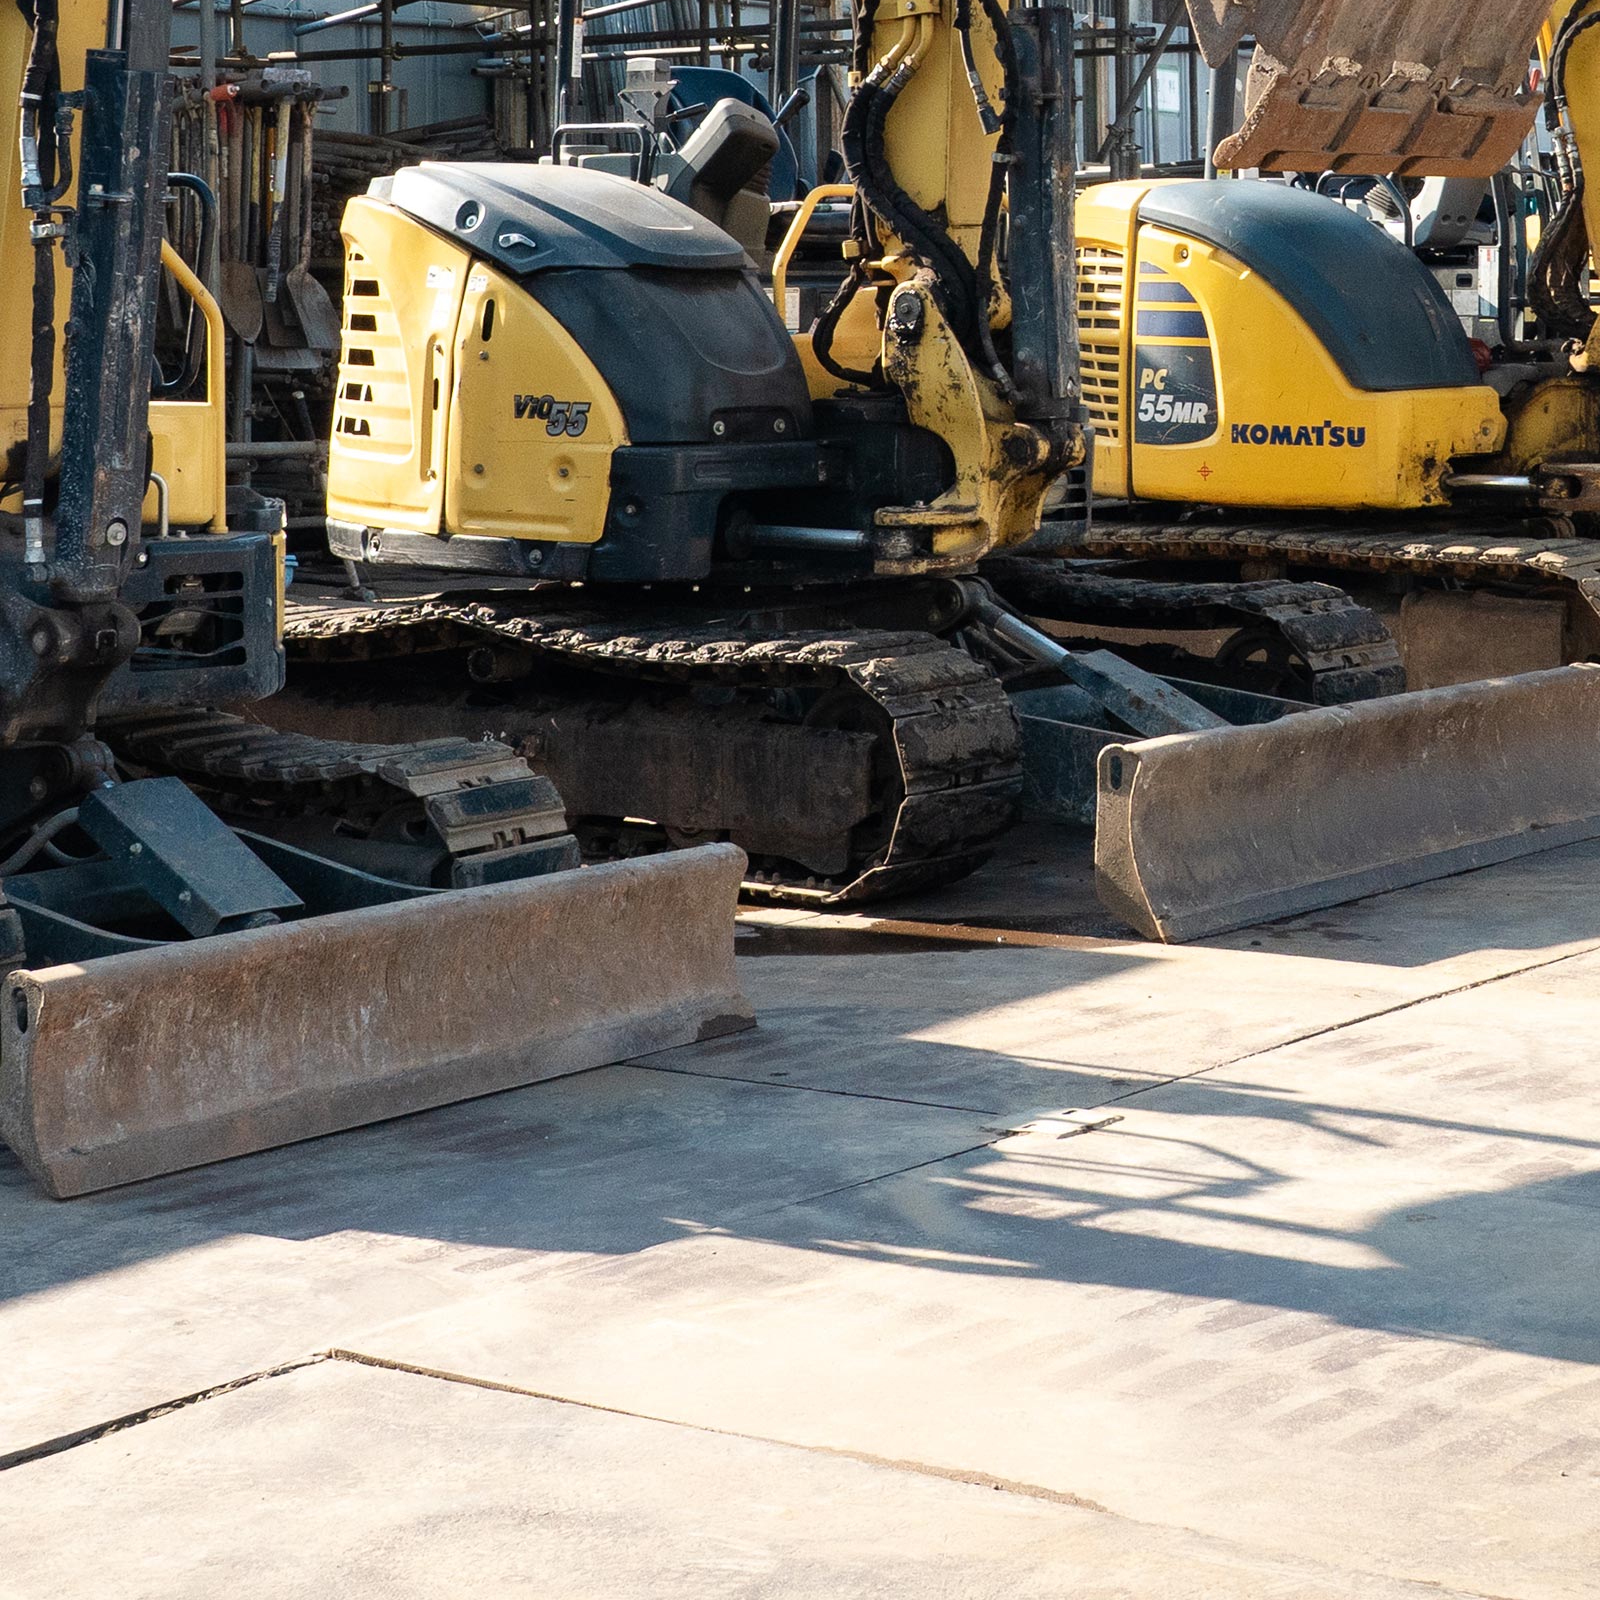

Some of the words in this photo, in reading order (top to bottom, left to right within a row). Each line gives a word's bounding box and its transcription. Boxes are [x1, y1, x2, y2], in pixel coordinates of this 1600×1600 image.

[1140, 368, 1168, 390] PC
[1138, 393, 1208, 424] 55MR
[1231, 420, 1366, 447] KOMATSU
